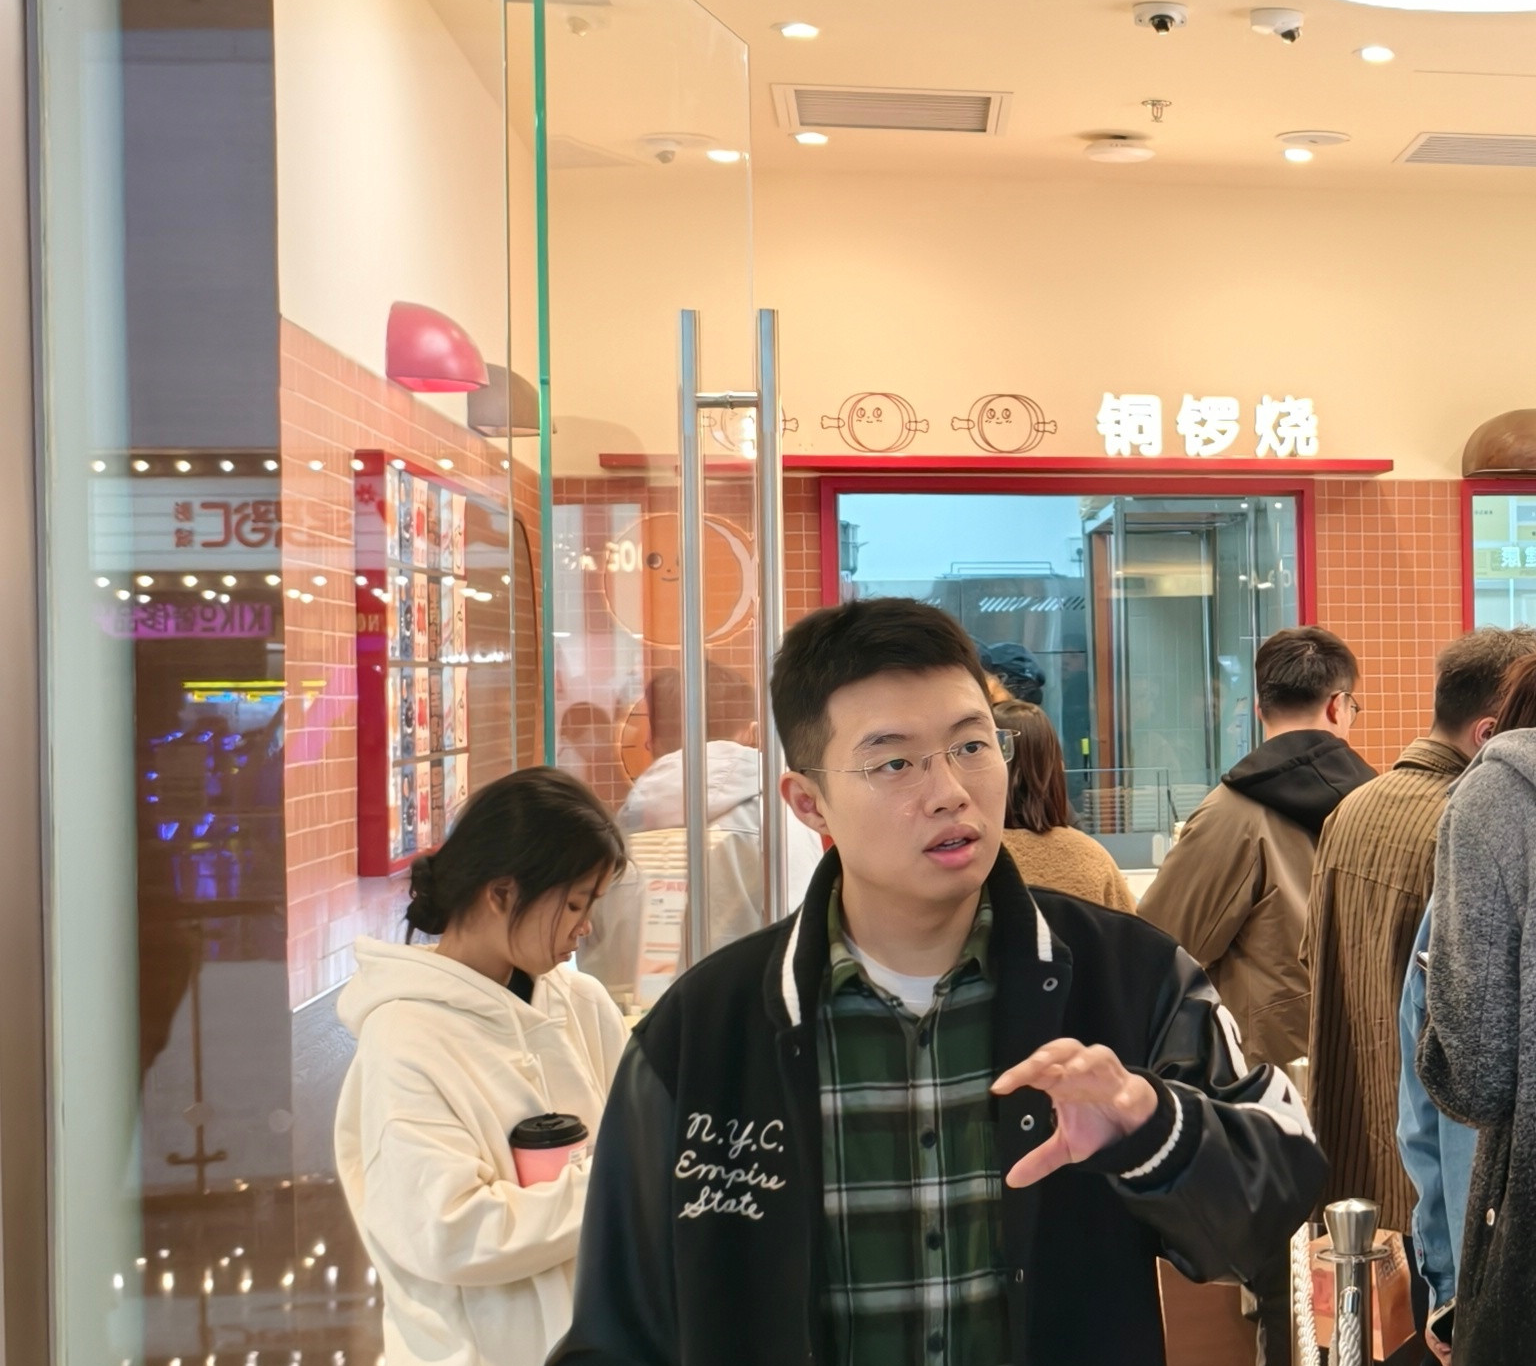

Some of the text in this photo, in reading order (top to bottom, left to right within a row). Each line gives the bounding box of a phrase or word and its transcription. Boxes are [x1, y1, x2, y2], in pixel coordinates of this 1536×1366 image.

[1096, 392, 1320, 458] 铜锣烧
[675, 1149, 787, 1190] Empire
[678, 1185, 765, 1220] State
